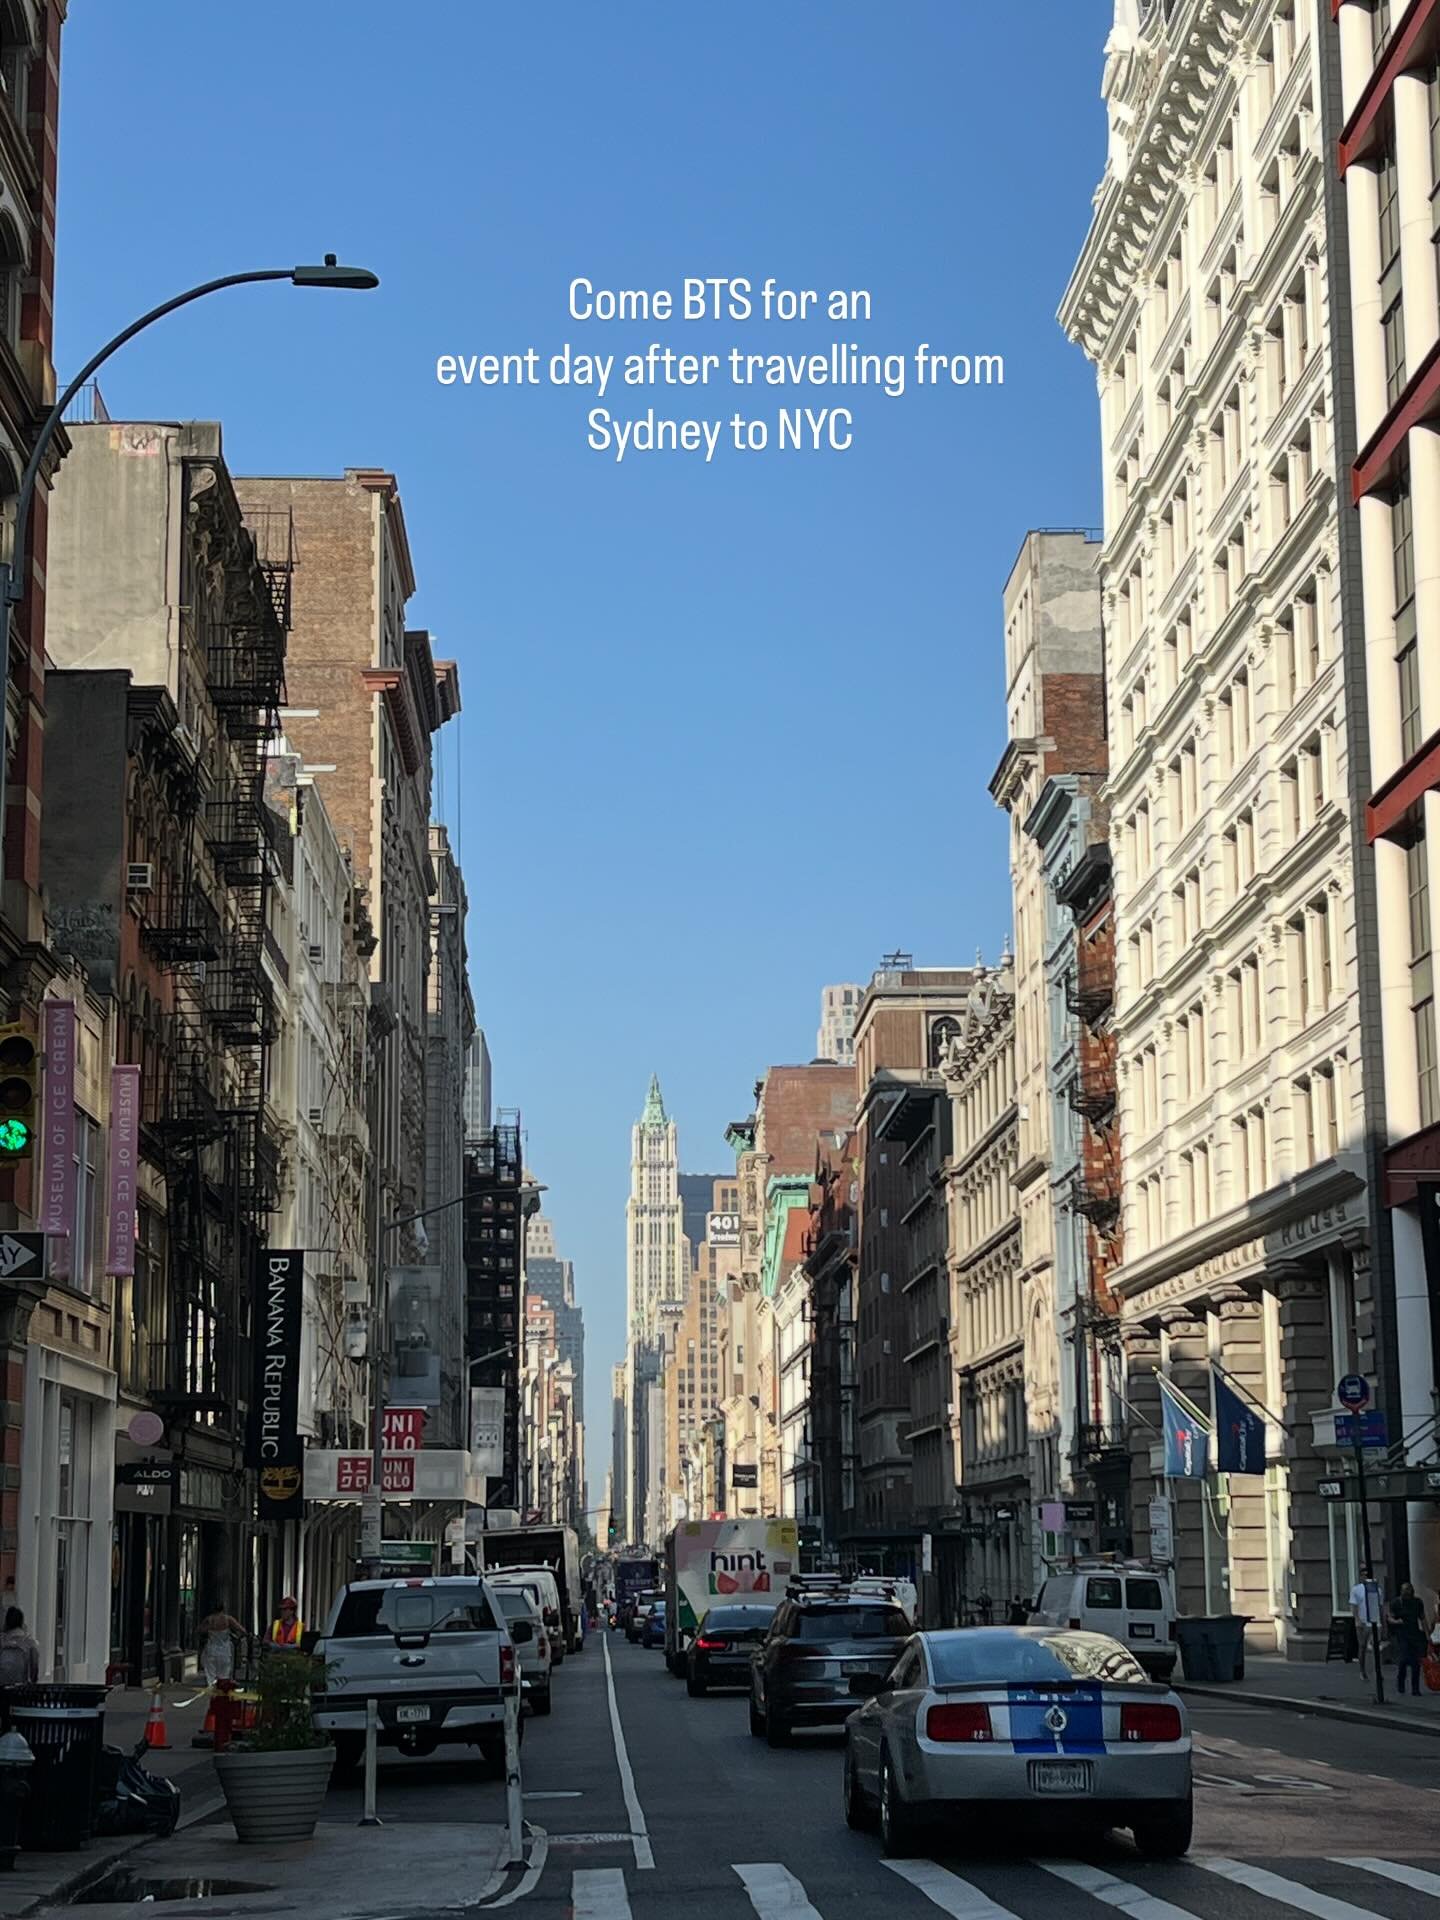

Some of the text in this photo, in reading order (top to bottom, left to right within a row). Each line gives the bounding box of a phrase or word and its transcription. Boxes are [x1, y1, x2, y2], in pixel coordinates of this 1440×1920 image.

[48, 1007, 67, 1231] MUSEUM OF ICE CREAM
[114, 1072, 133, 1270] MUSEUM OF ICE CREAM
[710, 1215, 739, 1230] 401
[266, 1257, 290, 1347] BANANA
[260, 1355, 286, 1458] REPUBLIC
[133, 1469, 172, 1479] ALDO
[342, 1461, 367, 1474] ユニ
[383, 1461, 409, 1474] UNI
[341, 1475, 368, 1488] クロ
[383, 1475, 411, 1490] QLO
[711, 1551, 767, 1571] hint
